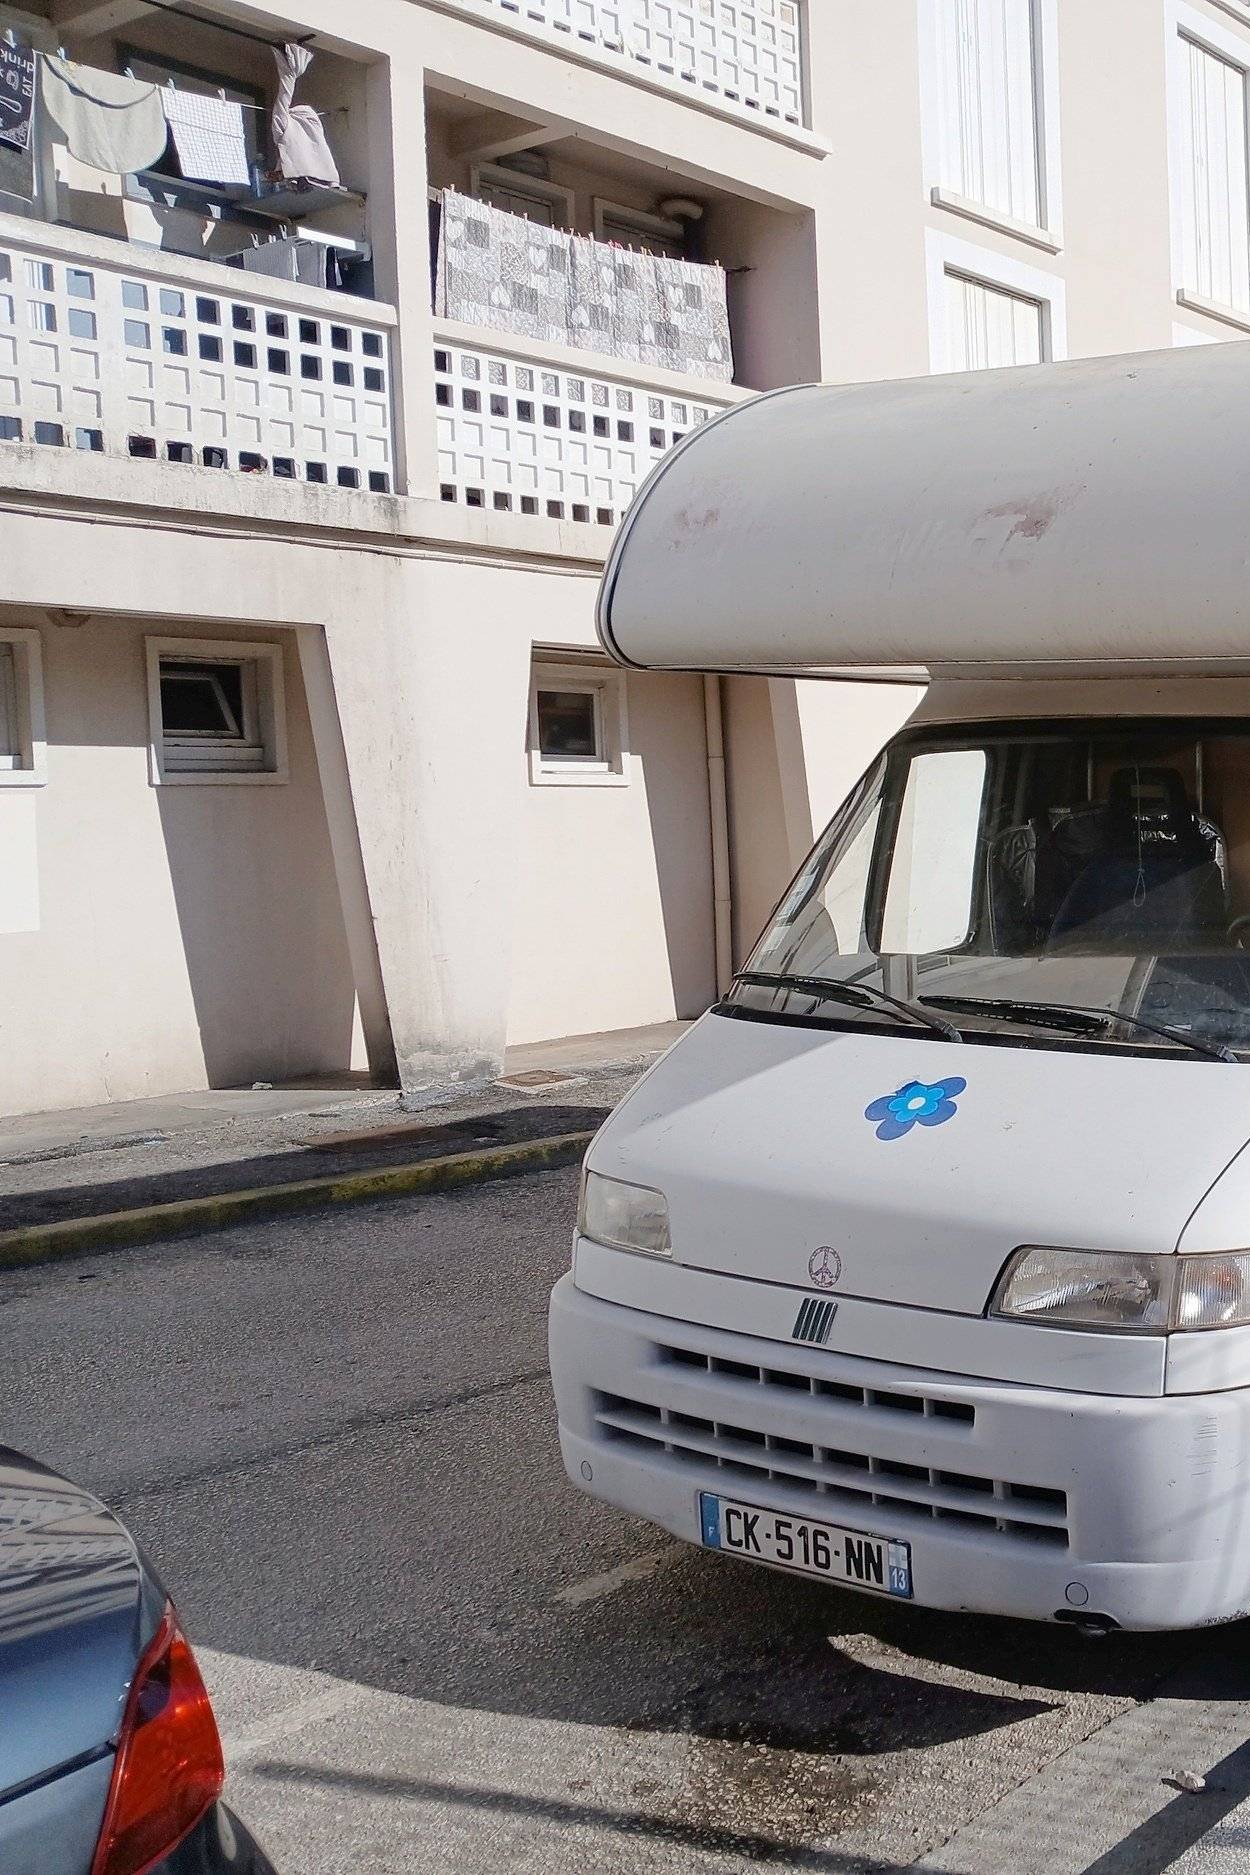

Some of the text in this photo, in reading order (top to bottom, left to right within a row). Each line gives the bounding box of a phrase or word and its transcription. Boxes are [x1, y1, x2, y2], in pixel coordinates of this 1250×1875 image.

[21, 76, 32, 98] EAT
[708, 1526, 715, 1538] F
[725, 1508, 883, 1584] CK-516-NN
[891, 1570, 906, 1591] 13
